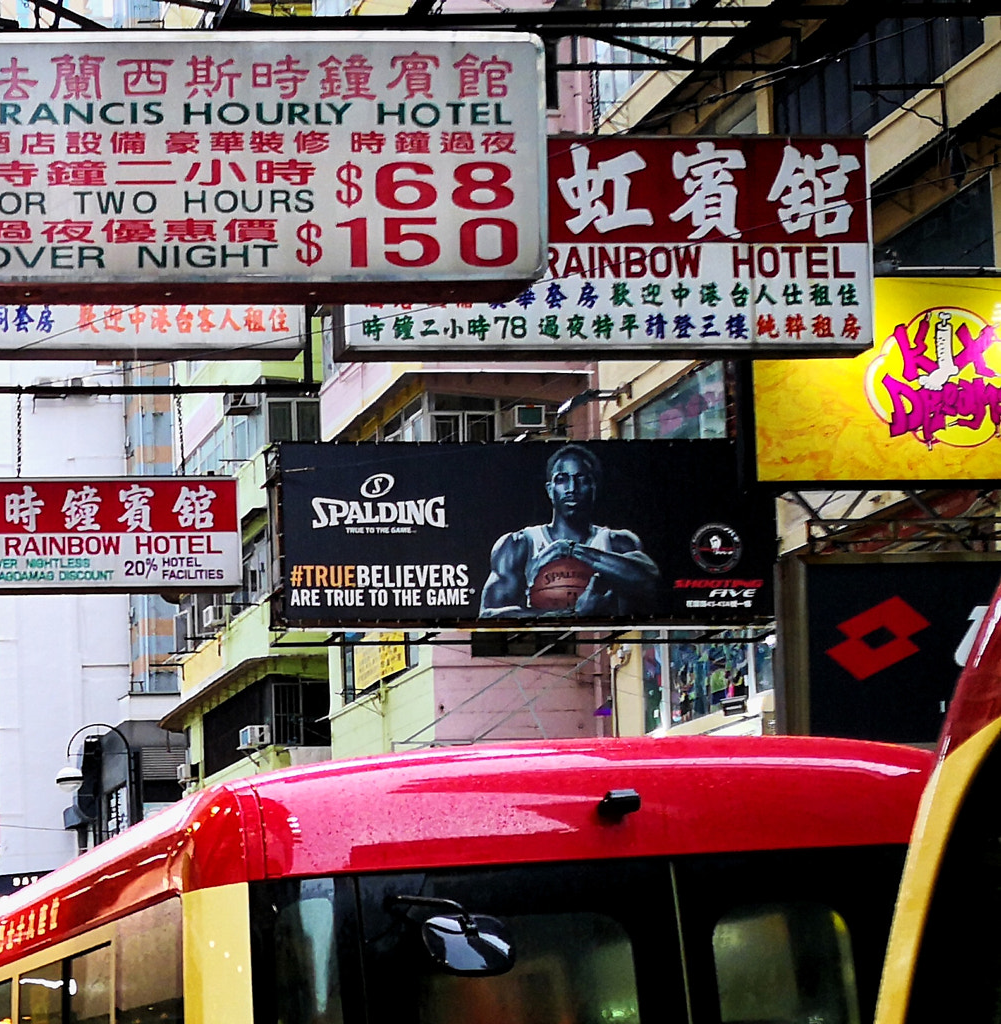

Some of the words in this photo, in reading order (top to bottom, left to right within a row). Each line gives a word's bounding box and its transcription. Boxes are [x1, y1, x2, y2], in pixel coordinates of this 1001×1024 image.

[183, 102, 354, 126] HOURLY
[377, 102, 512, 127] HOTEL
[164, 131, 331, 155] 豪華裝修
[351, 131, 517, 155] 時鐘過夜
[336, 160, 516, 212] $68
[74, 190, 158, 214] TWO
[183, 188, 316, 214] HOURS
[295, 216, 519, 269] $150
[138, 243, 279, 269] NIGHT
[732, 246, 856, 279] HOTEL
[311, 495, 447, 529] SPALDING
[4, 536, 121, 557] RAINBOW
[135, 535, 224, 556] HOTEL
[124, 559, 159, 579] 20%
[161, 557, 202, 568] HOTEL
[161, 568, 225, 581] FACILITIES
[290, 564, 469, 588] #TRUEBELIEVERS
[291, 589, 321, 607] ARE
[324, 589, 365, 607] TRUE
[368, 589, 388, 607] TO
[392, 589, 422, 606] THE
[709, 588, 757, 598] FIVE
